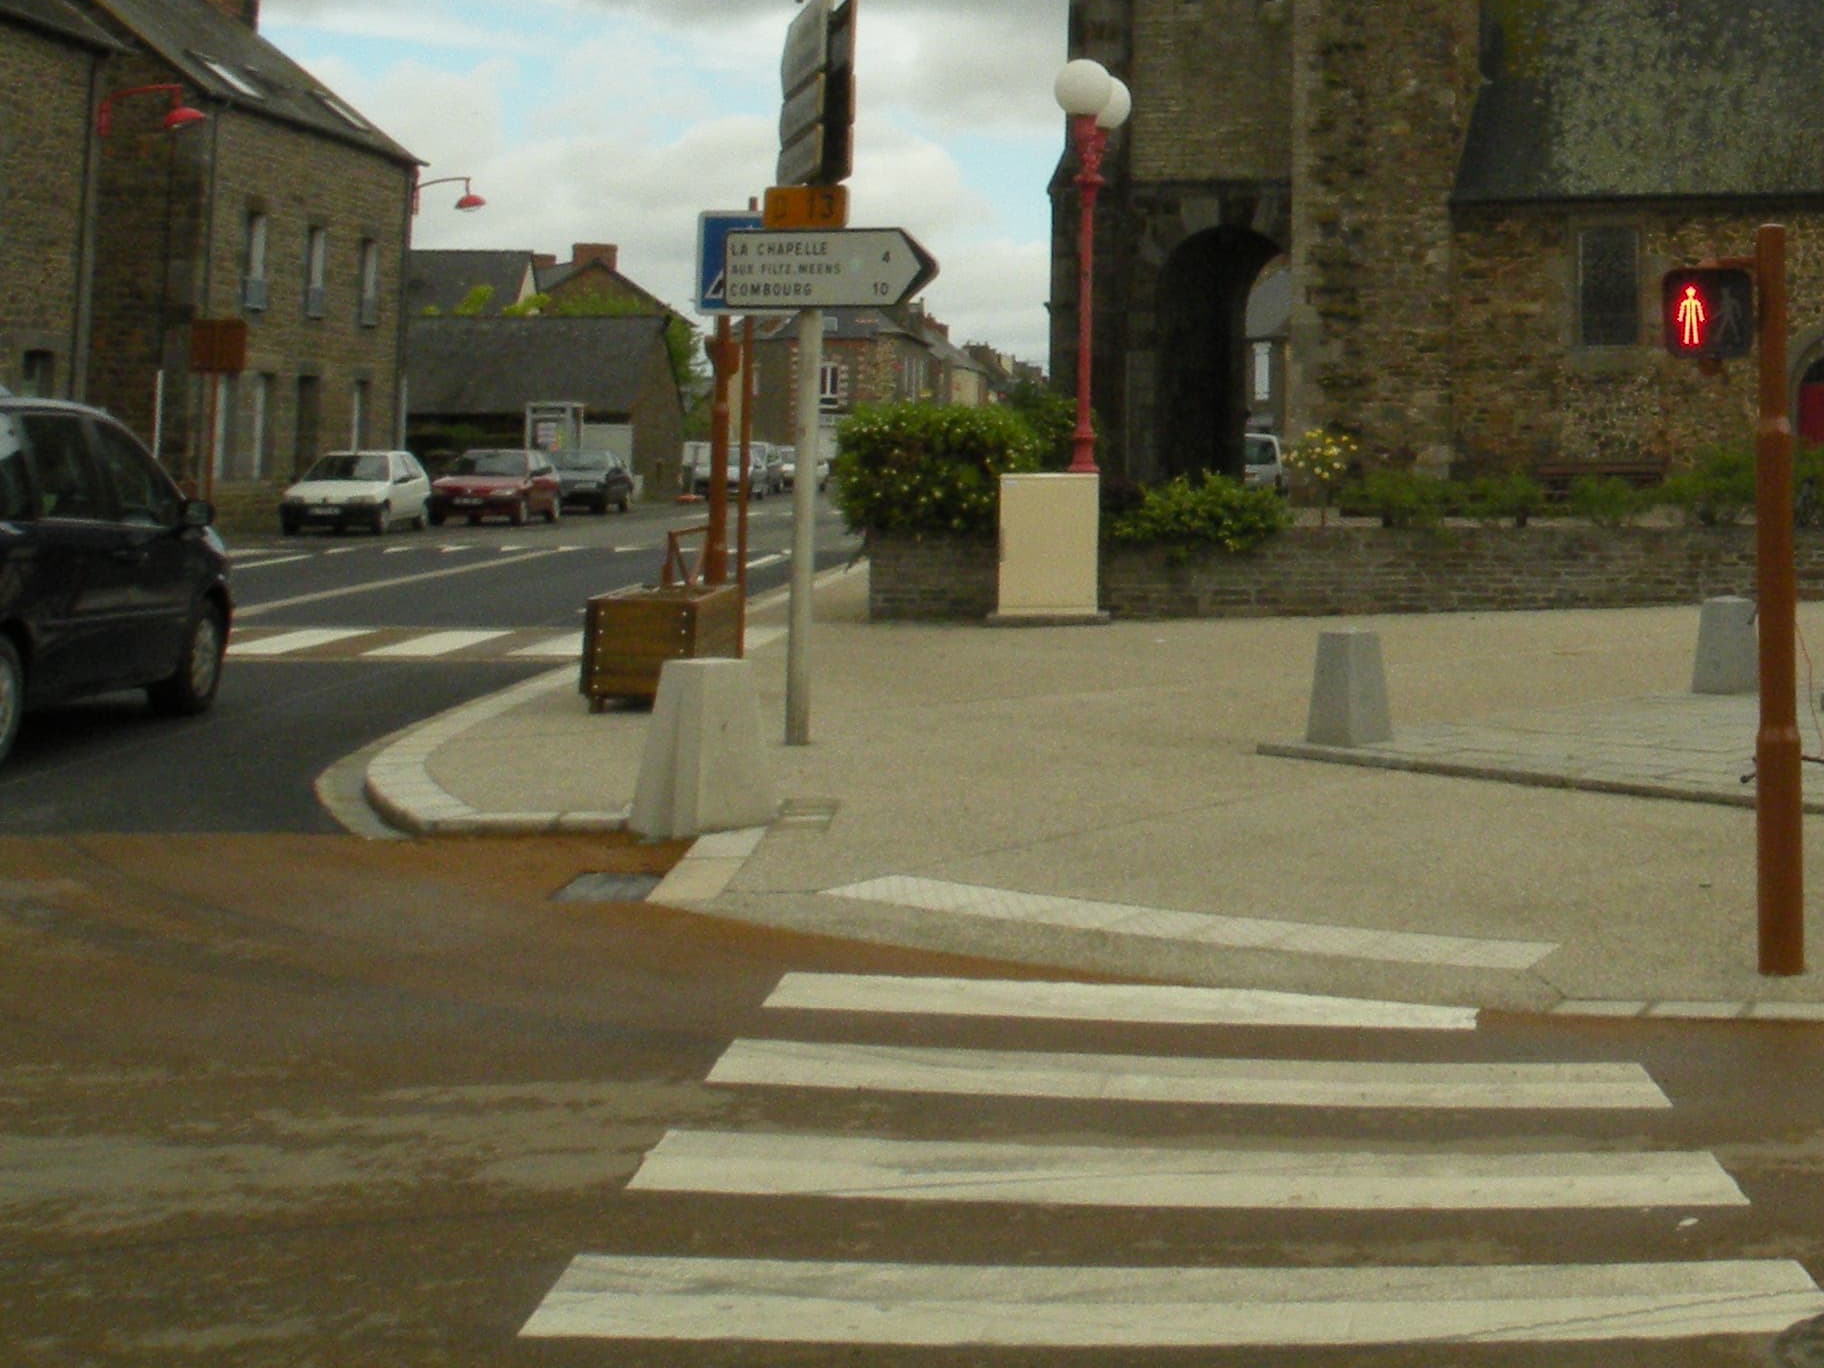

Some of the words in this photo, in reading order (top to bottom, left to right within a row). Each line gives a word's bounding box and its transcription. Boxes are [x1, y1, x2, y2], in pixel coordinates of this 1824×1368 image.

[774, 194, 787, 219] D
[806, 193, 835, 219] 13
[730, 241, 749, 257] LA
[756, 240, 828, 257] CHAPELLE
[881, 250, 891, 264] 4
[730, 263, 754, 277] AUX
[729, 282, 813, 297] COMBOURG
[873, 281, 890, 296] 10
